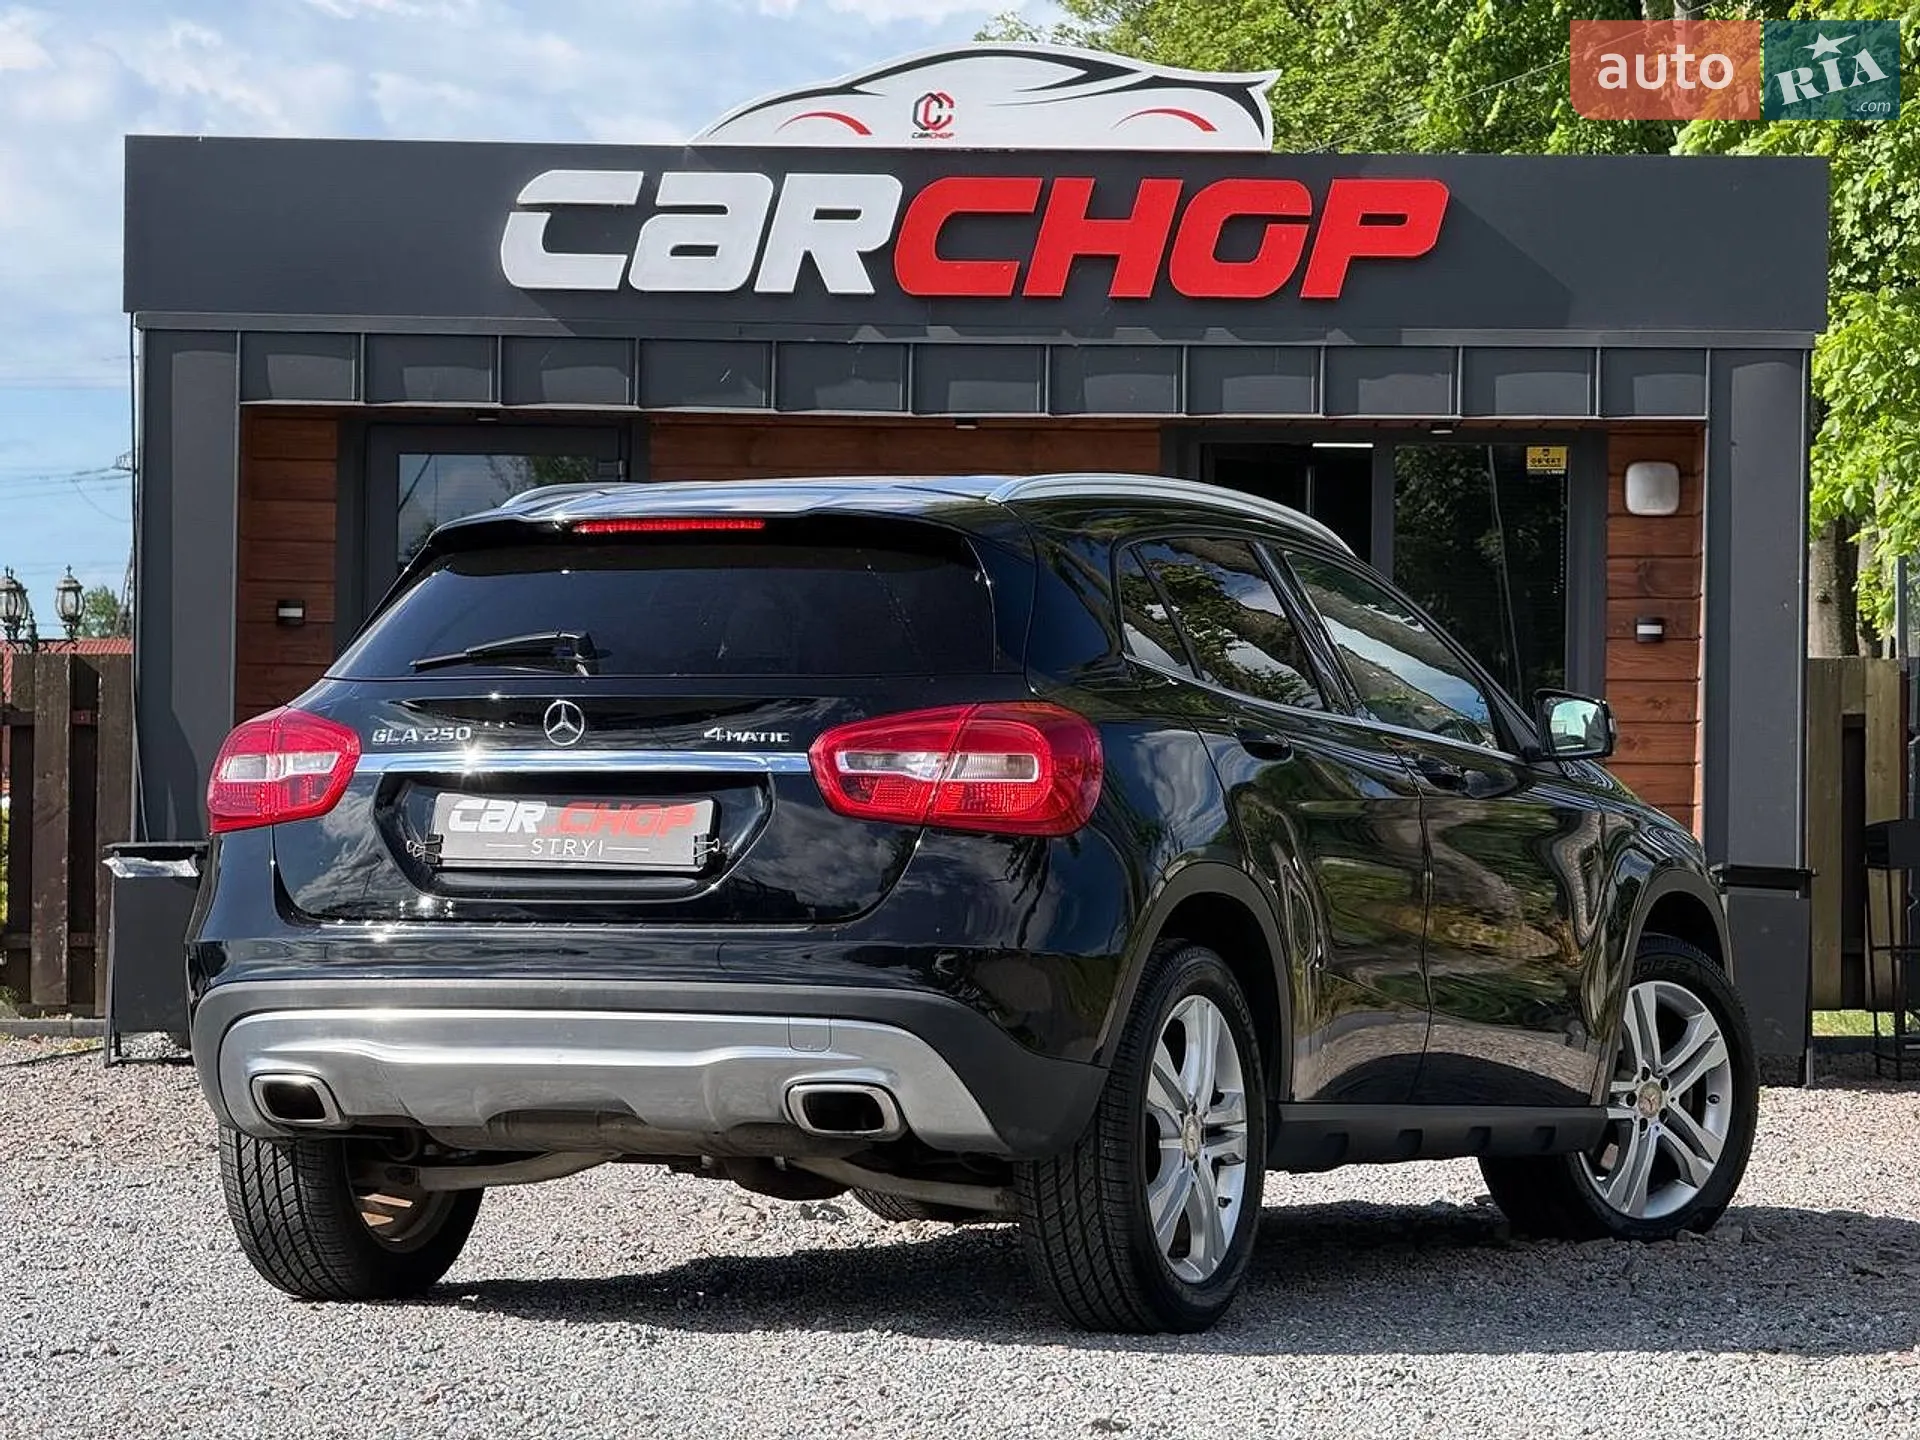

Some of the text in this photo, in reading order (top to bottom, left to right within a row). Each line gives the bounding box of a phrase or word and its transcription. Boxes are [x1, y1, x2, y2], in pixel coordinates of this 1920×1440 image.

[372, 726, 471, 744] GLA 250
[704, 727, 790, 743] 4MATIC
[559, 802, 697, 837] CHOP
[530, 837, 603, 857] STRYI
